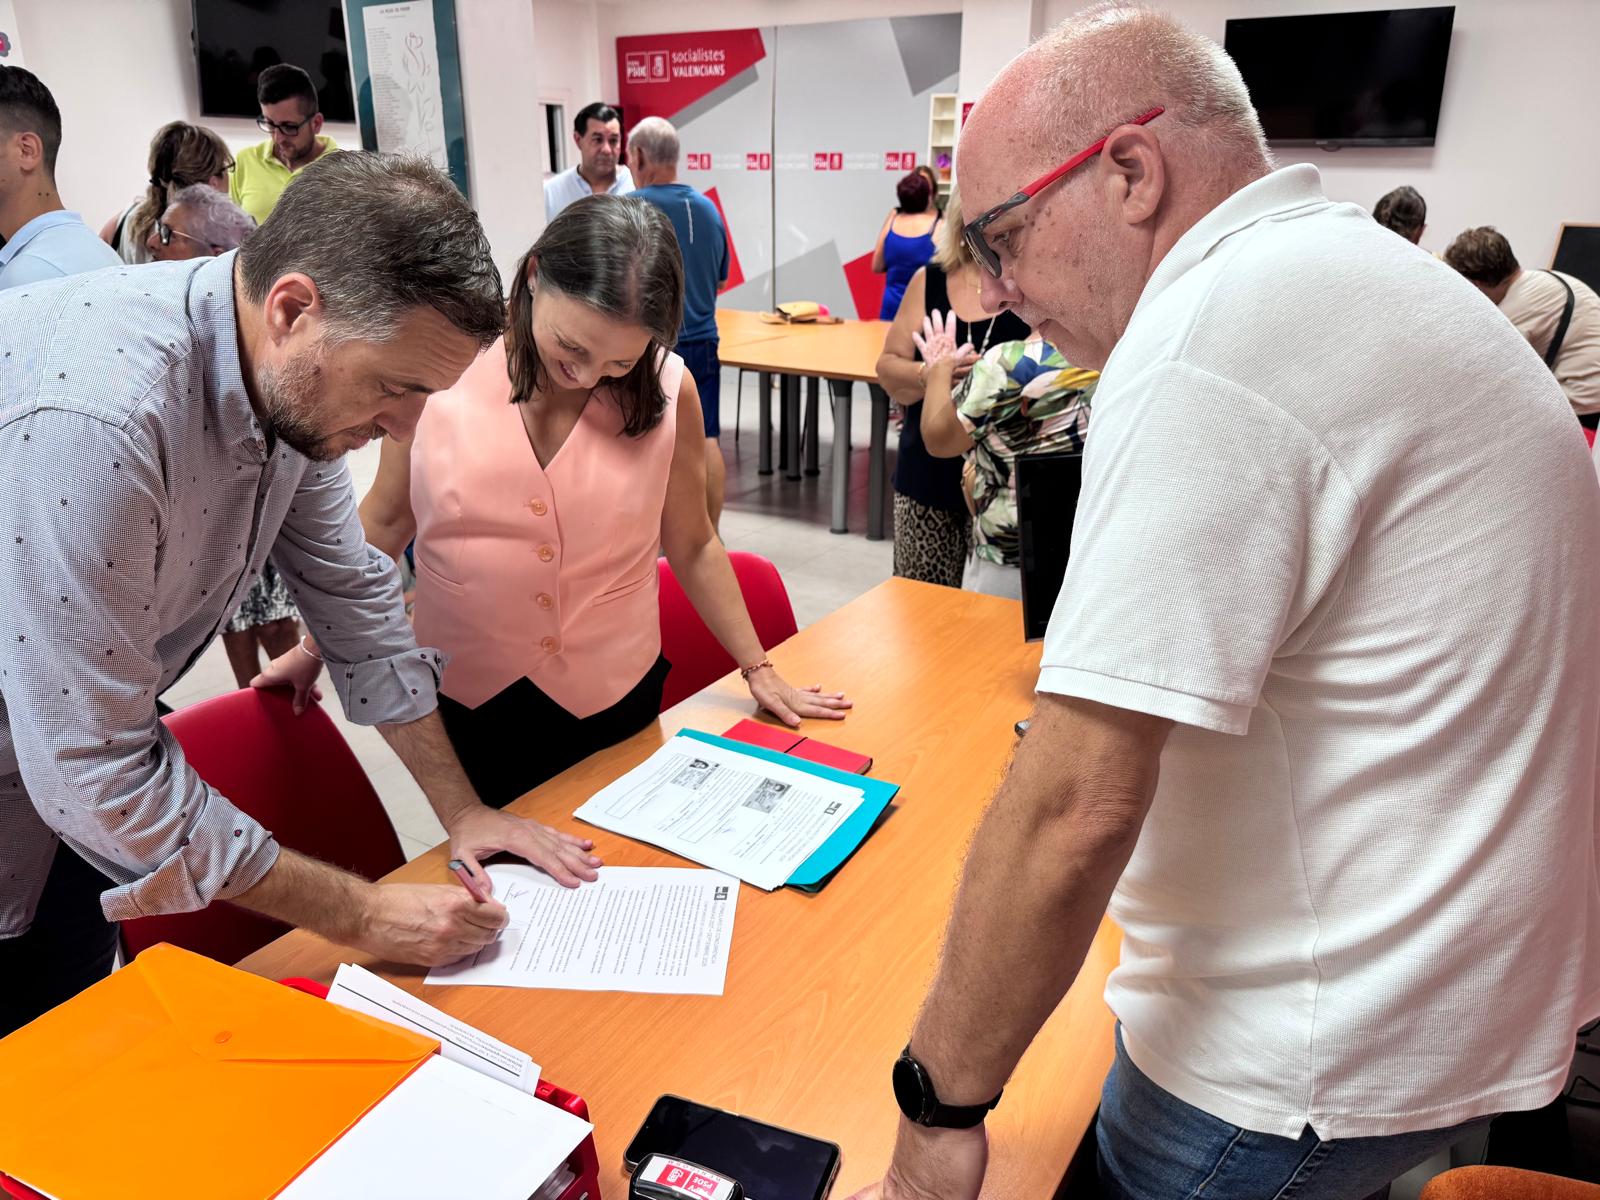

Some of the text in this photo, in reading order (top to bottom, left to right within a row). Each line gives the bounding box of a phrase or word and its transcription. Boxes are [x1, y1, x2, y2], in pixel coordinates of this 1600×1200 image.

[672, 48, 725, 63] socialistes
[672, 64, 725, 77] VALENCIANS
[692, 1176, 713, 1189] PSOE
